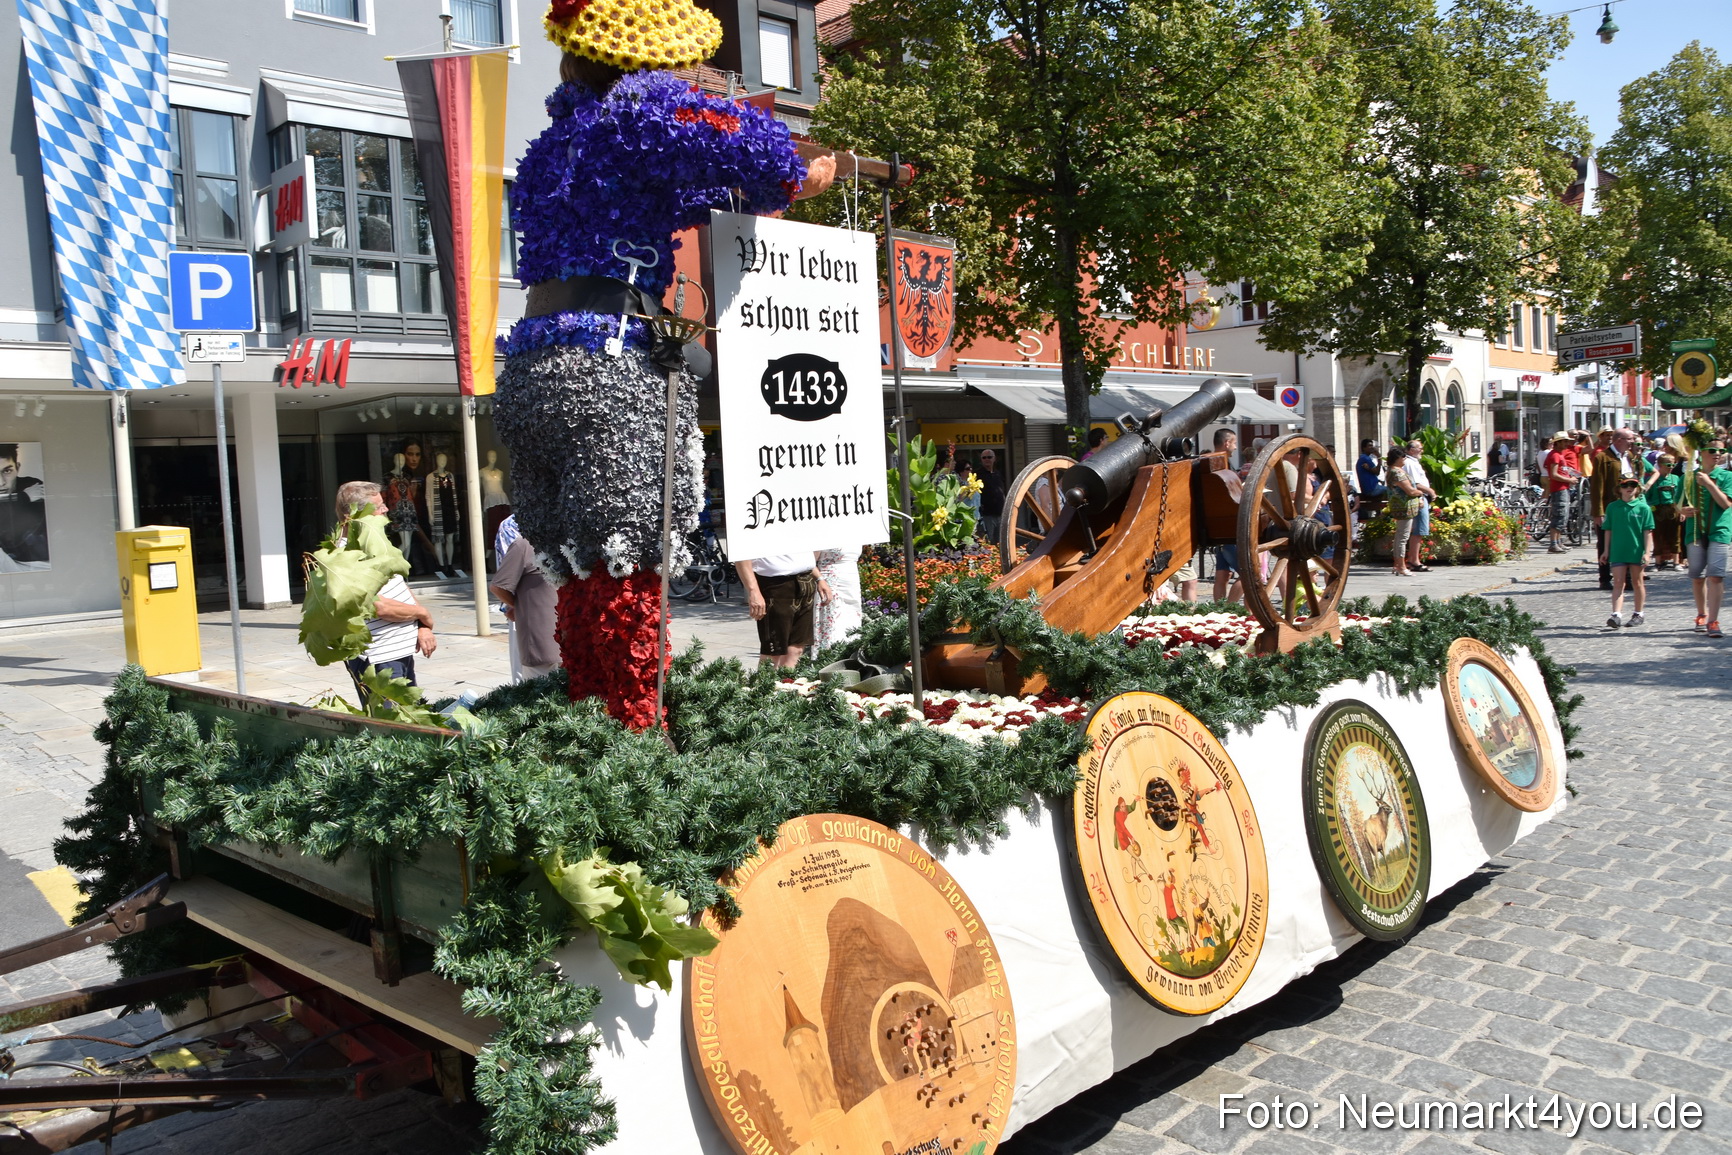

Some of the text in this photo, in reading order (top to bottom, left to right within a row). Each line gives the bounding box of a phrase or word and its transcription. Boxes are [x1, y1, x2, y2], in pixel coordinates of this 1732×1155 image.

[735, 235, 859, 284] Wir leben
[189, 263, 233, 321] P
[740, 296, 860, 336] schon seit
[1569, 330, 1623, 345] Parkleitsystem
[277, 337, 352, 389] H&M
[1117, 341, 1216, 368] SCHLIERF
[1588, 345, 1624, 357] Rosengasse
[772, 370, 838, 405] 1433
[758, 434, 857, 477] gerne in
[955, 433, 1005, 443] SCHLIERF
[743, 484, 874, 530] Neumarkt
[1087, 756, 1100, 779] von
[1108, 709, 1136, 734] König
[1137, 708, 1149, 722] an
[1174, 714, 1189, 738] 65.
[1317, 722, 1341, 768] Geburtstag
[821, 820, 903, 854] gewidmet
[909, 849, 937, 880] von
[938, 876, 980, 935] Herrn
[975, 934, 1006, 1001] Franz
[1145, 965, 1195, 997] gewonnen
[1198, 980, 1214, 997] von
